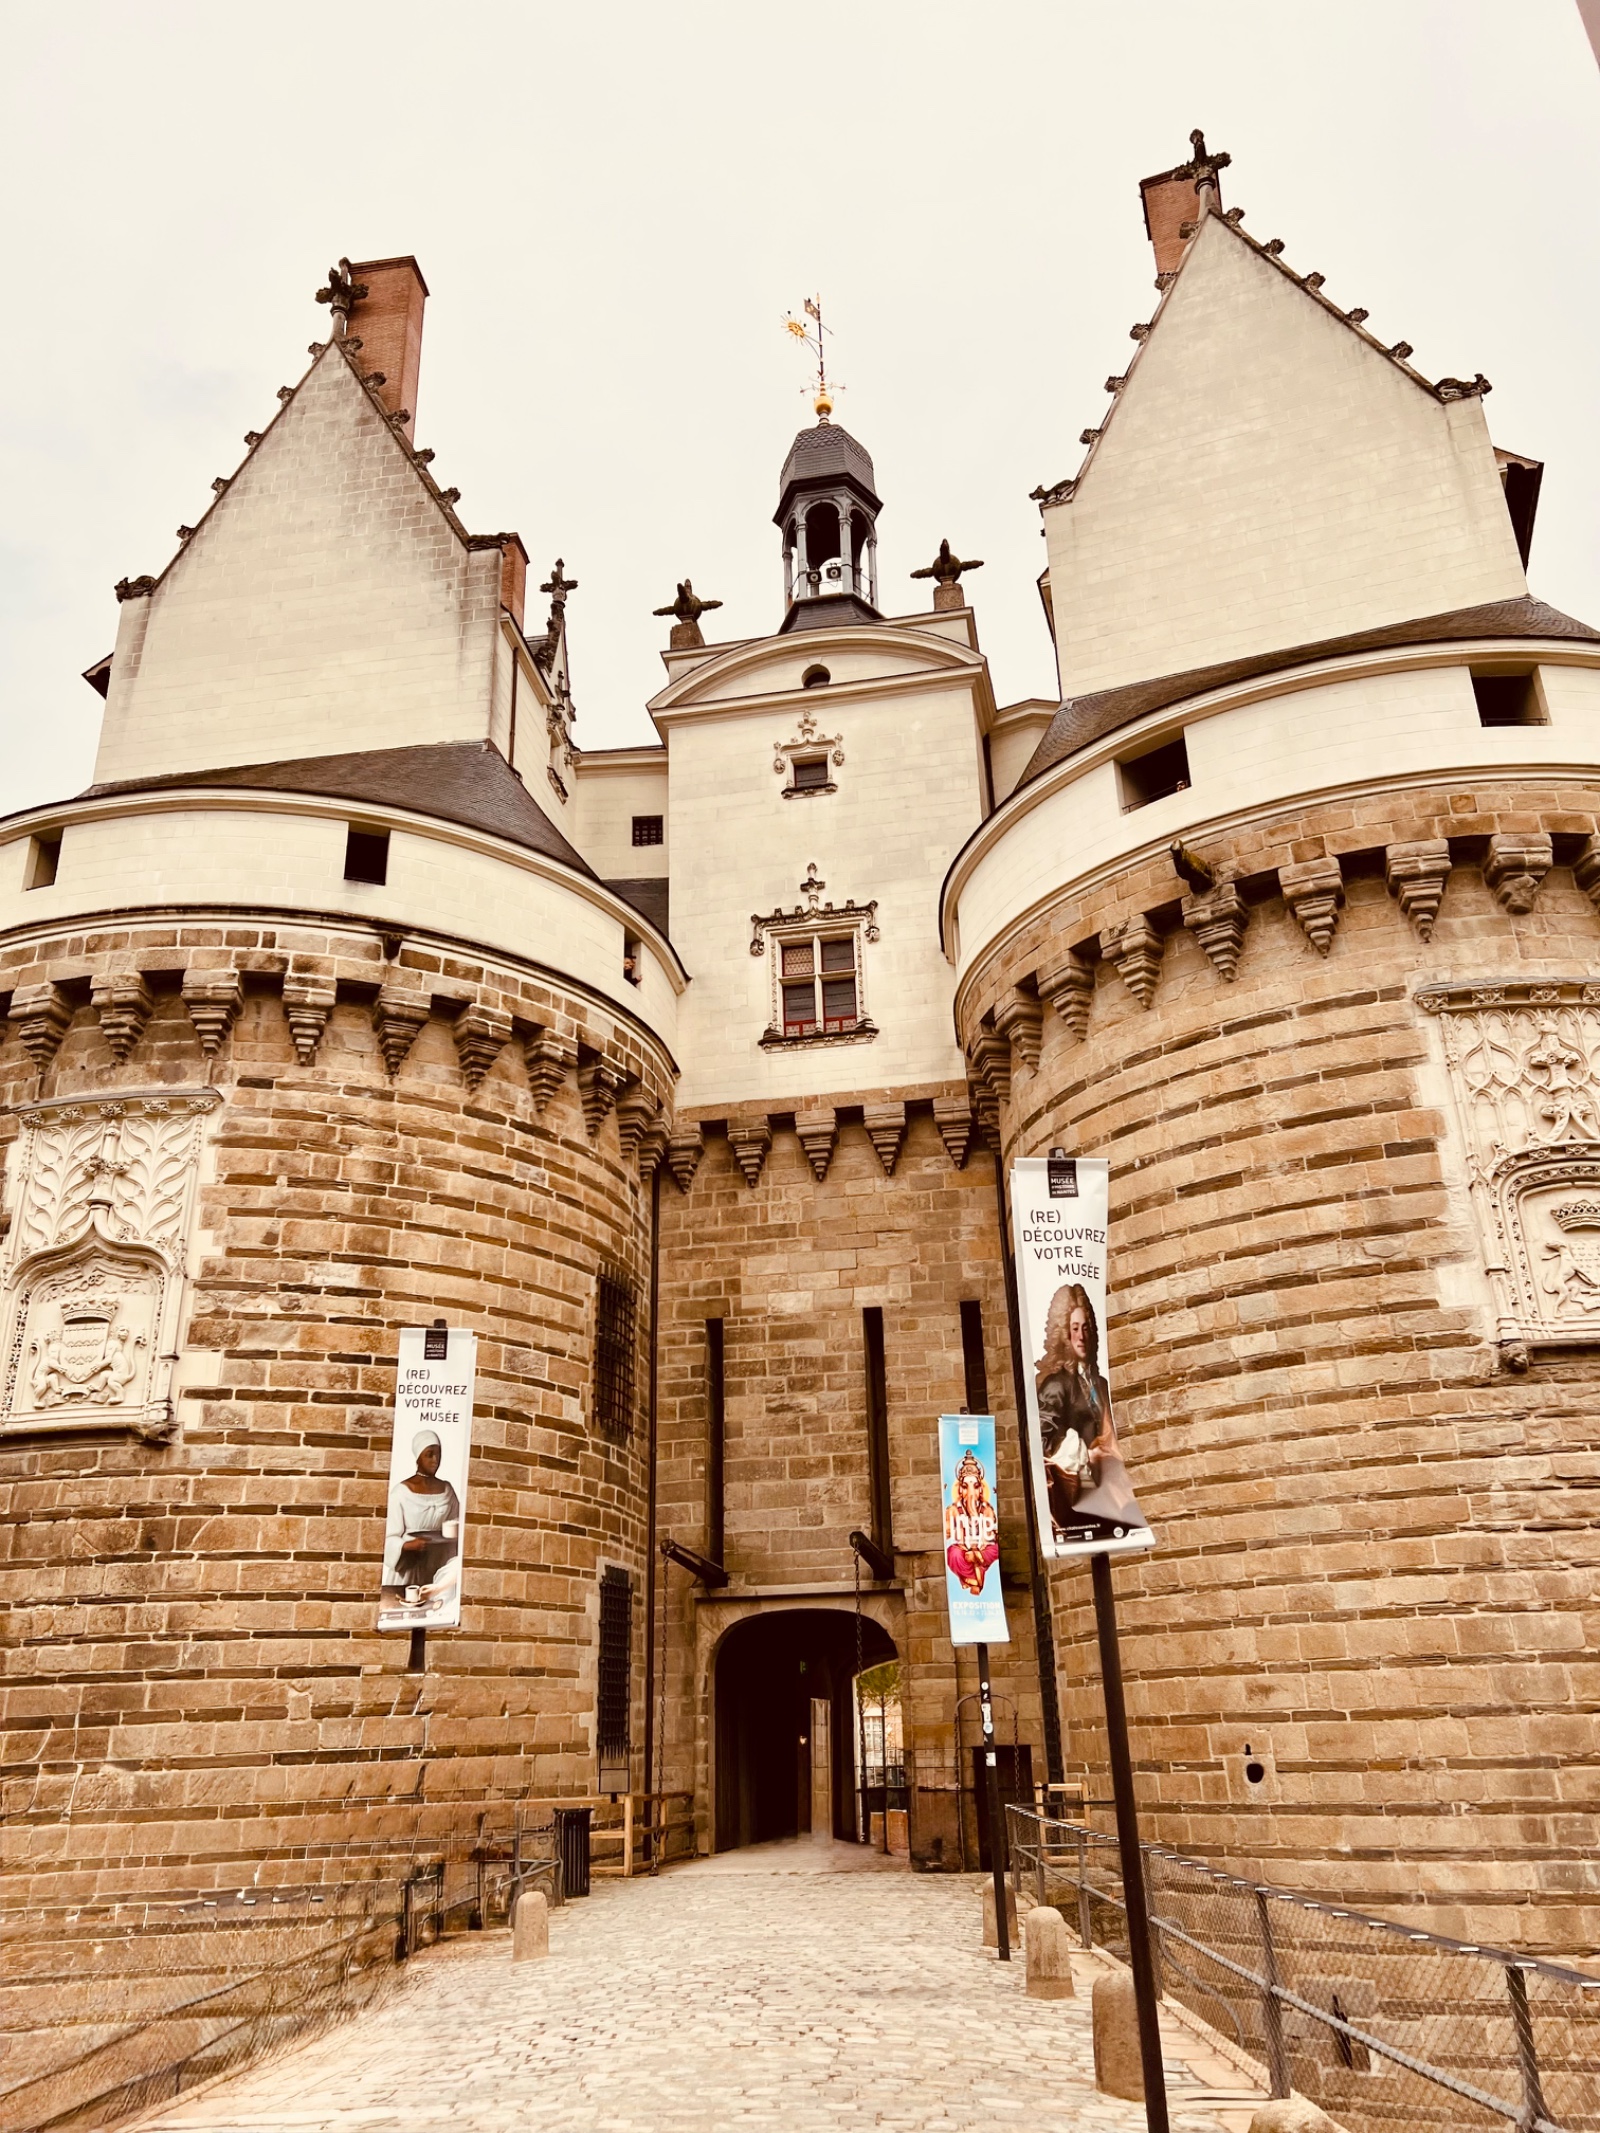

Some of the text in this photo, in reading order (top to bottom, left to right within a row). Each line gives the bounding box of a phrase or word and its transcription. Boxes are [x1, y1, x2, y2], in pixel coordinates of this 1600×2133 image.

[1030, 1209, 1061, 1224] (RE)
[1022, 1226, 1106, 1244] DÉCOUVREZ
[1033, 1245, 1083, 1260] VOTRE
[1057, 1261, 1100, 1279] MUSÉE
[406, 1368, 431, 1380] (RE)
[398, 1382, 468, 1395] DÉCOUVREZ
[404, 1398, 442, 1408] VOTRE
[419, 1410, 460, 1423] MUSÉE
[952, 1601, 1001, 1610] EXPOSITION
